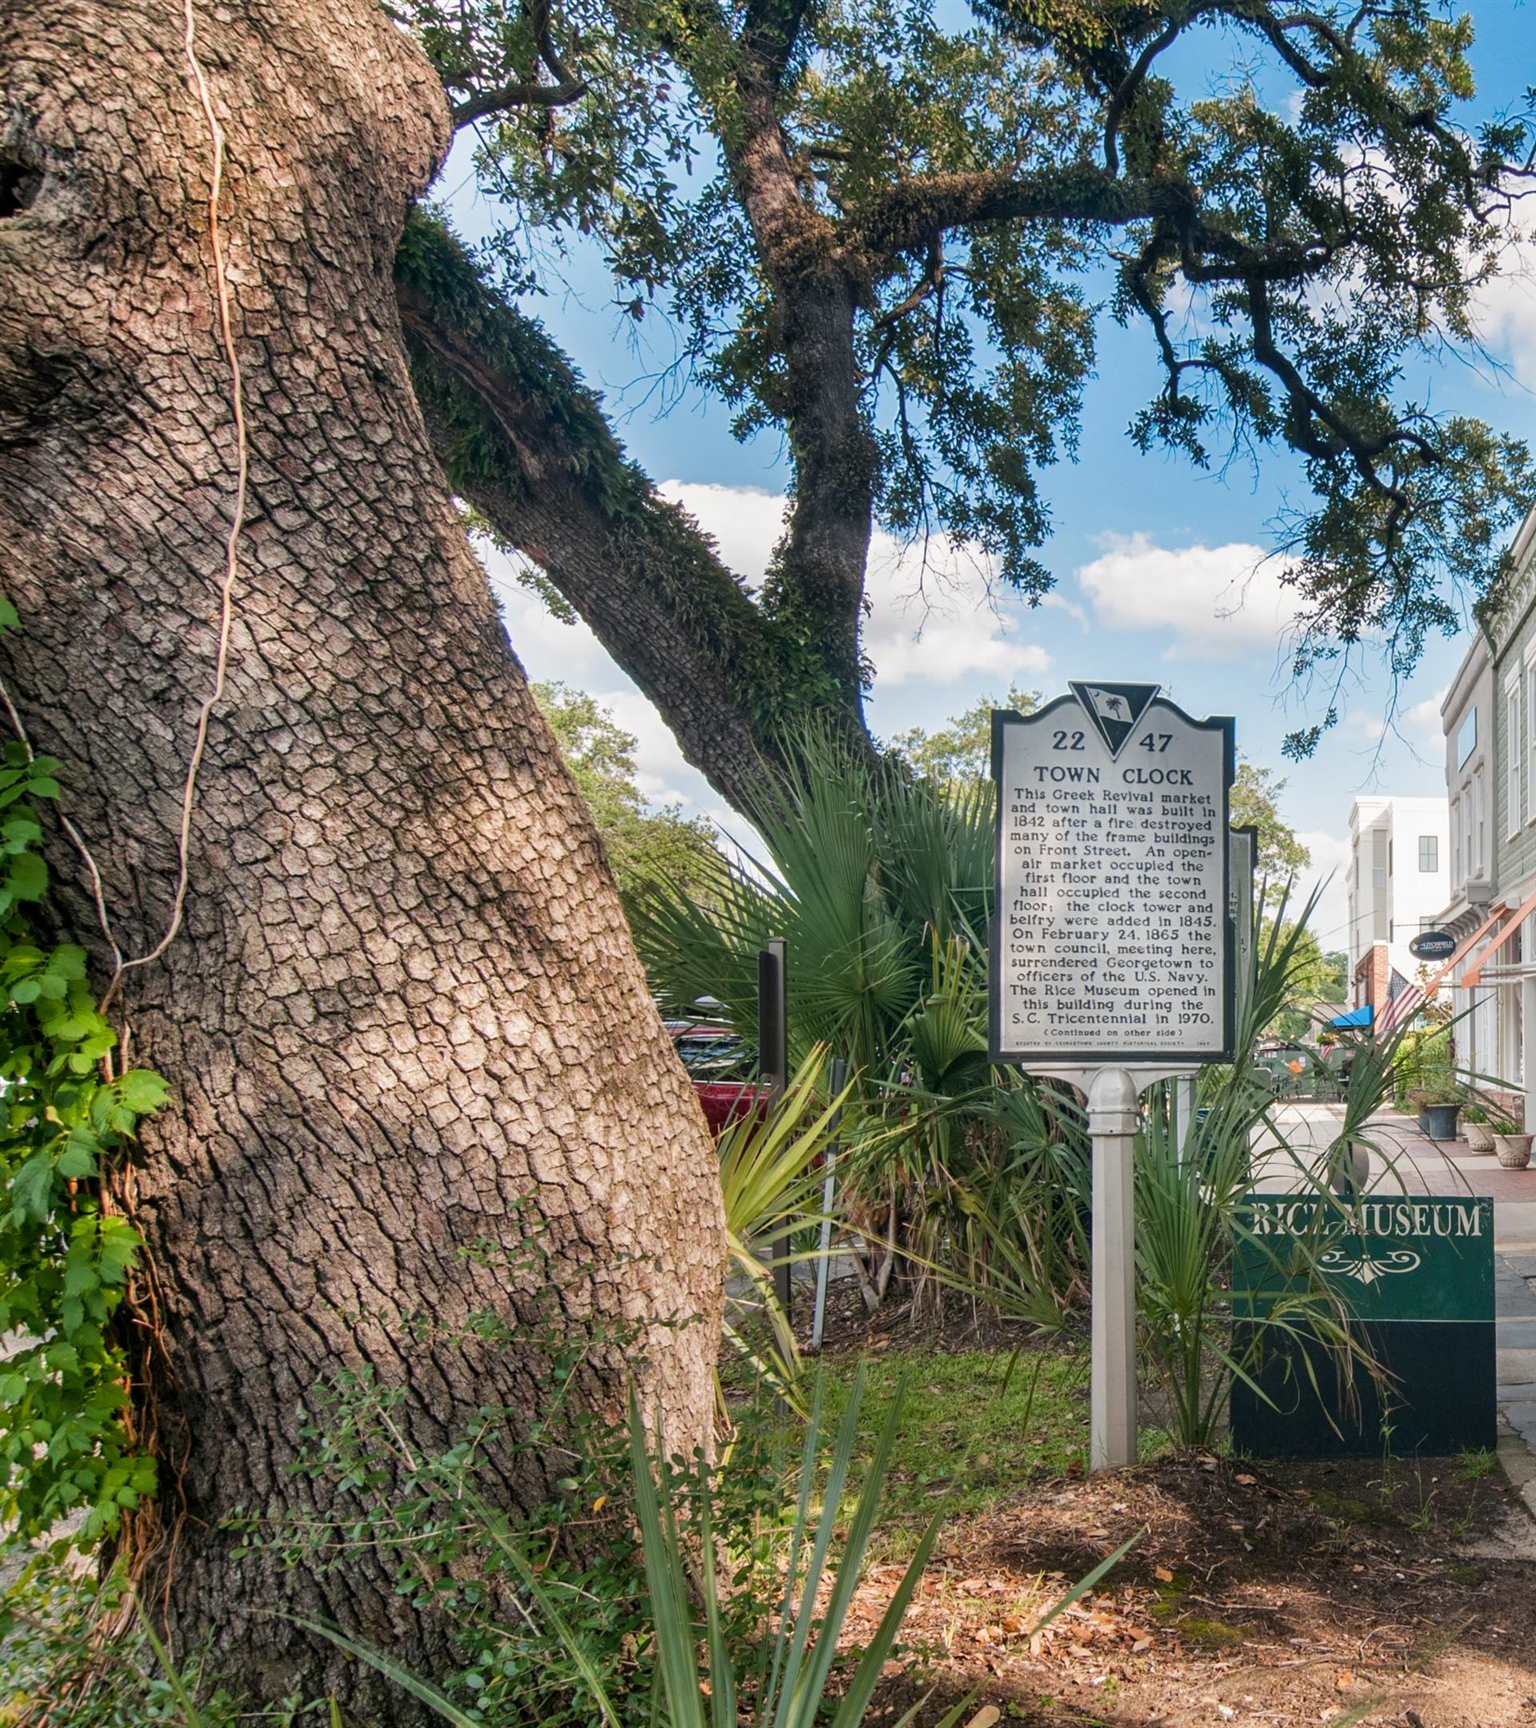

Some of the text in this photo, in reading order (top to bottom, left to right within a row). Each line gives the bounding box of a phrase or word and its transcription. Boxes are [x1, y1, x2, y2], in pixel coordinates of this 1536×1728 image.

[1053, 730, 1173, 752] 22 47
[1033, 766, 1193, 785] TOWN CLOCK
[1014, 788, 1211, 804] This Greek Revival market
[1011, 803, 1216, 818] and town hall was built in
[1014, 816, 1212, 833] 1842 after a fire destroyed
[1010, 830, 1215, 846] many of the frame buildings
[1014, 845, 1213, 860] on Front Street. An open-
[1022, 859, 1204, 873] air market occupied the
[1025, 873, 1201, 886] first floor and the town
[1020, 886, 1206, 900] hall occupied the second
[1067, 901, 1090, 911] the
[1098, 901, 1135, 912] clock
[1143, 902, 1182, 913] tower
[1188, 903, 1213, 913] and
[1010, 914, 1217, 928] belfry were added in 1845.
[1012, 928, 1033, 939] On
[1042, 929, 1109, 943] February
[1147, 929, 1179, 940] 1865
[1189, 930, 1212, 941] the
[1010, 944, 1046, 953] town
[1117, 944, 1172, 957] meeting
[1182, 944, 1216, 956] here,
[1011, 957, 1214, 971] surrendered Georgetown to
[1017, 971, 1208, 984] officers of the U.S. Navy.
[1010, 984, 1215, 999] The Rice Museum opened in
[1024, 999, 1203, 1012] this building during the
[1048, 1013, 1146, 1024] Tricentennial
[1156, 1014, 1168, 1024] in
[1178, 1013, 1214, 1024] 1970.
[1124, 1029, 1151, 1037] other
